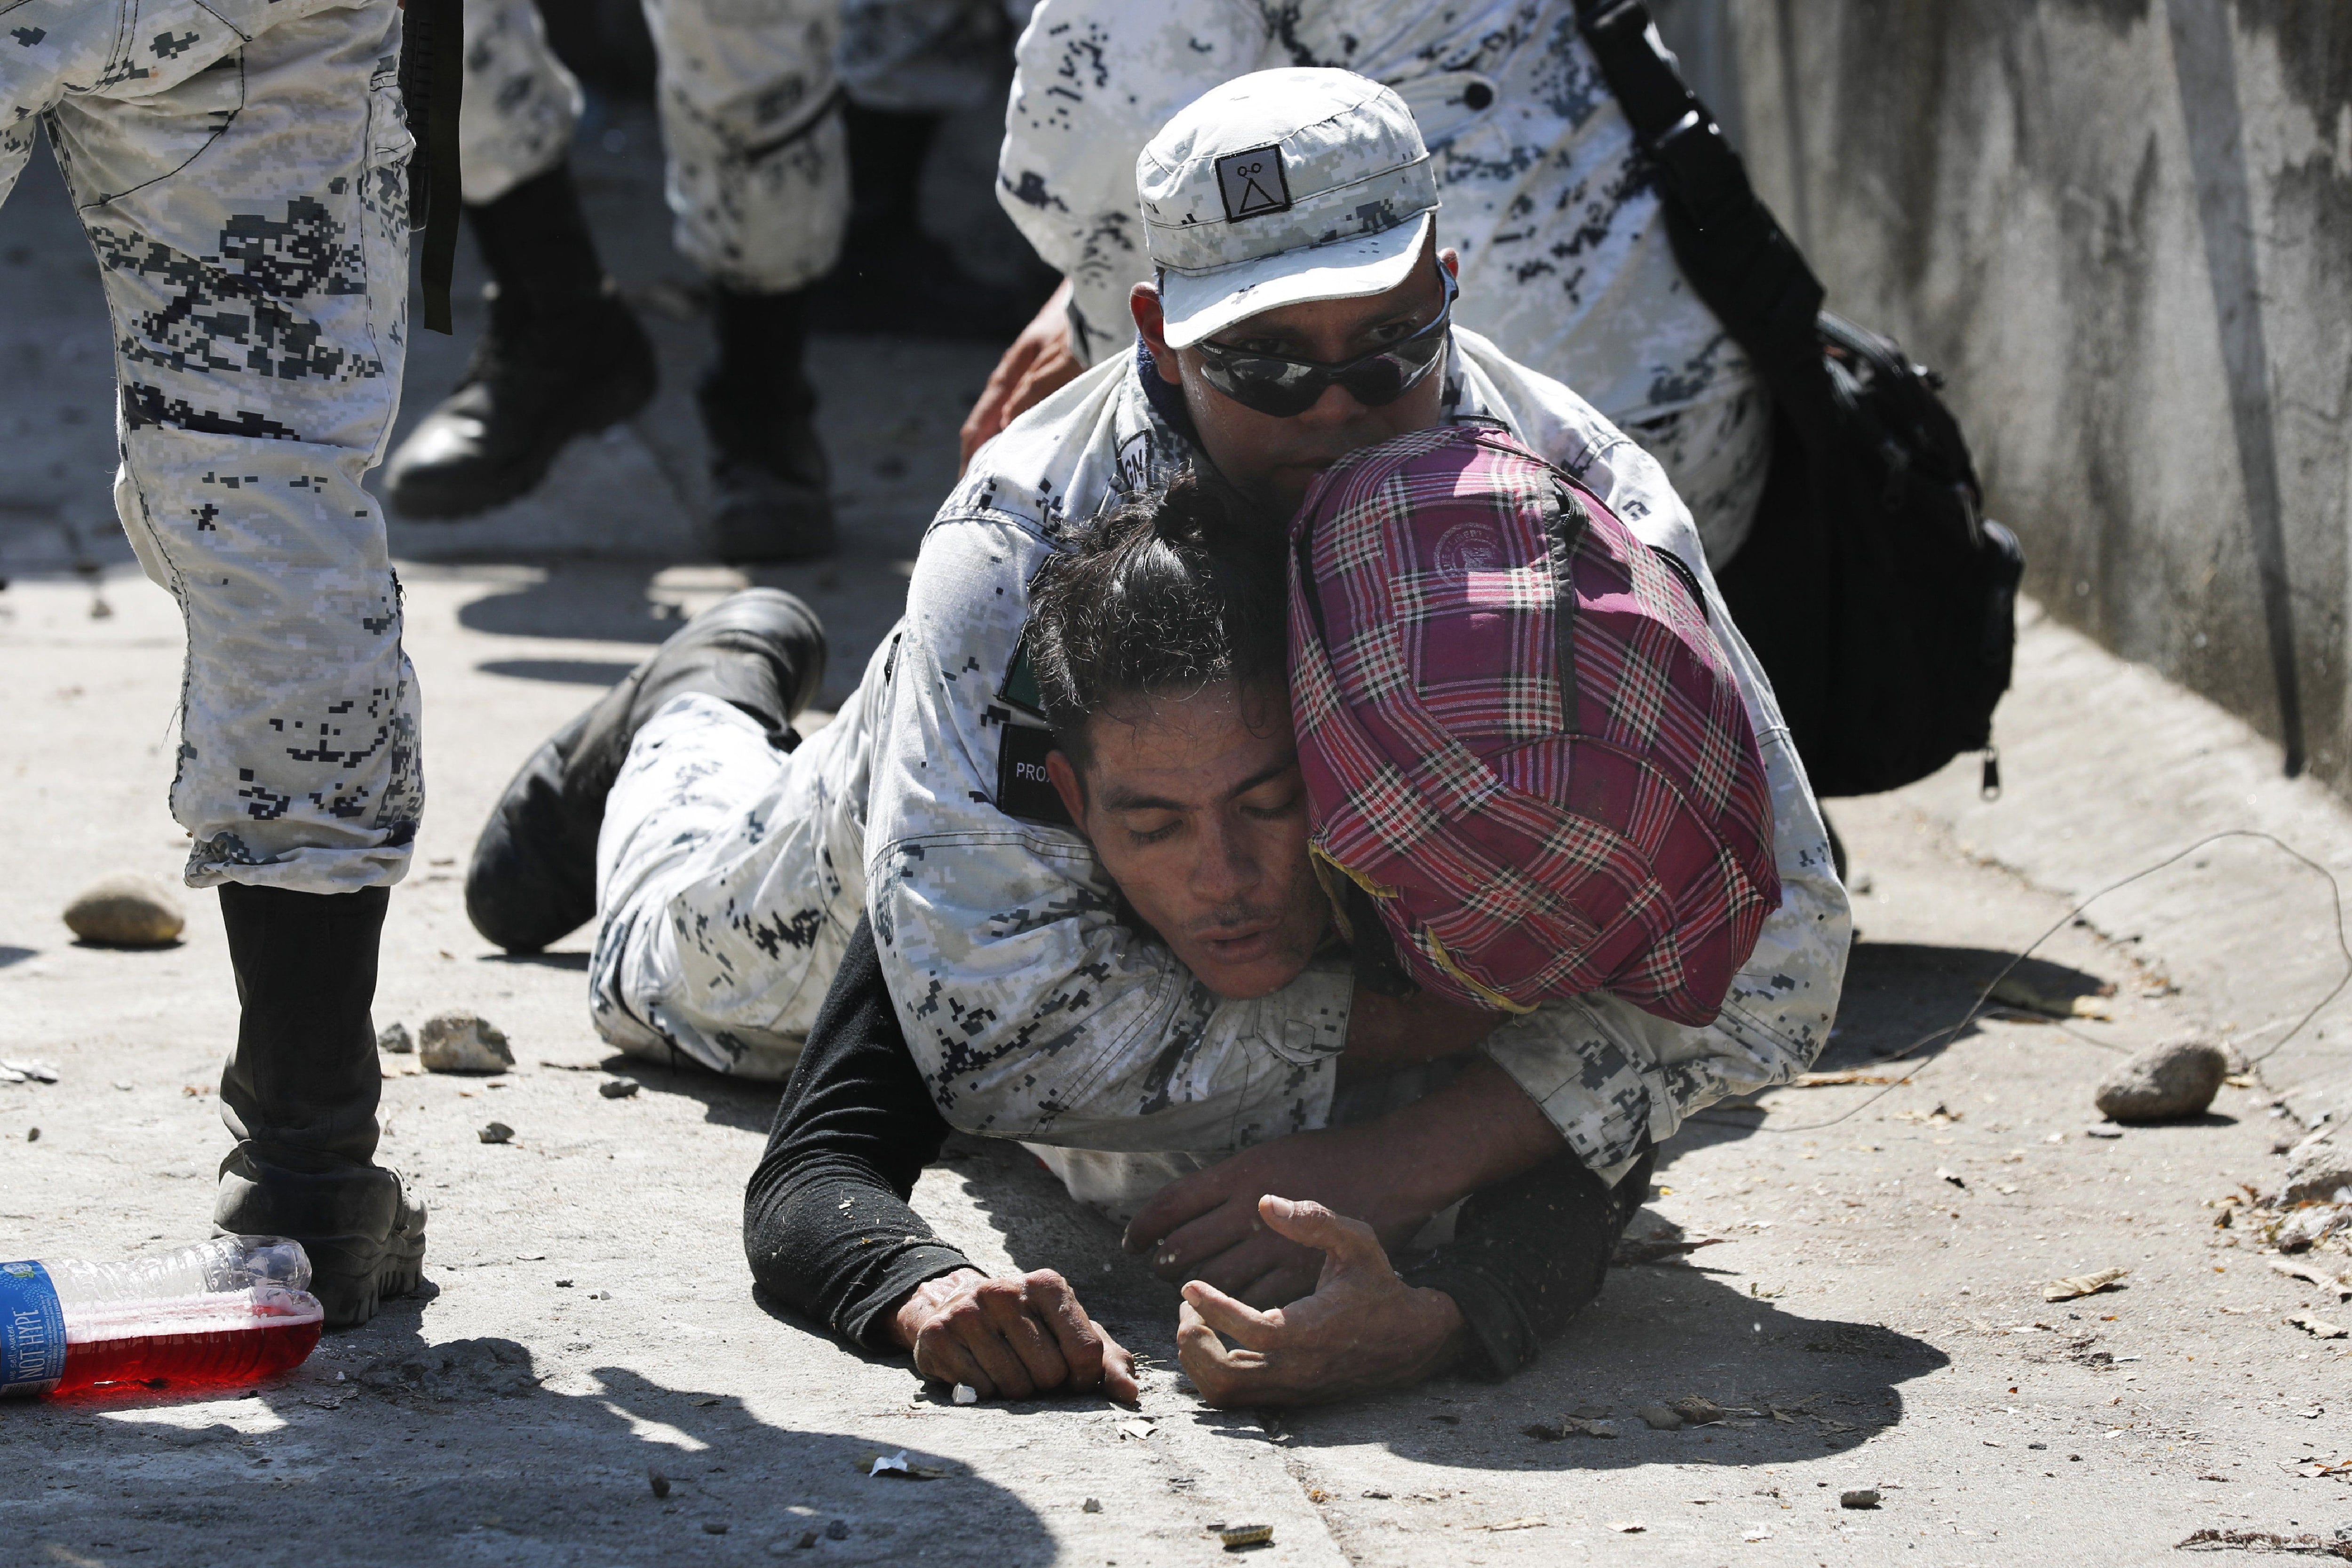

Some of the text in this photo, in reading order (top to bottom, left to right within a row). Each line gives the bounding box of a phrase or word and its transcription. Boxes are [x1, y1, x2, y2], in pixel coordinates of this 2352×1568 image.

[1125, 448, 1144, 487] GN
[1016, 762, 1050, 783] PRO
[13, 1309, 45, 1379] NOT HYPE
[8, 1353, 17, 1368] sell
[9, 1370, 16, 1381] we
